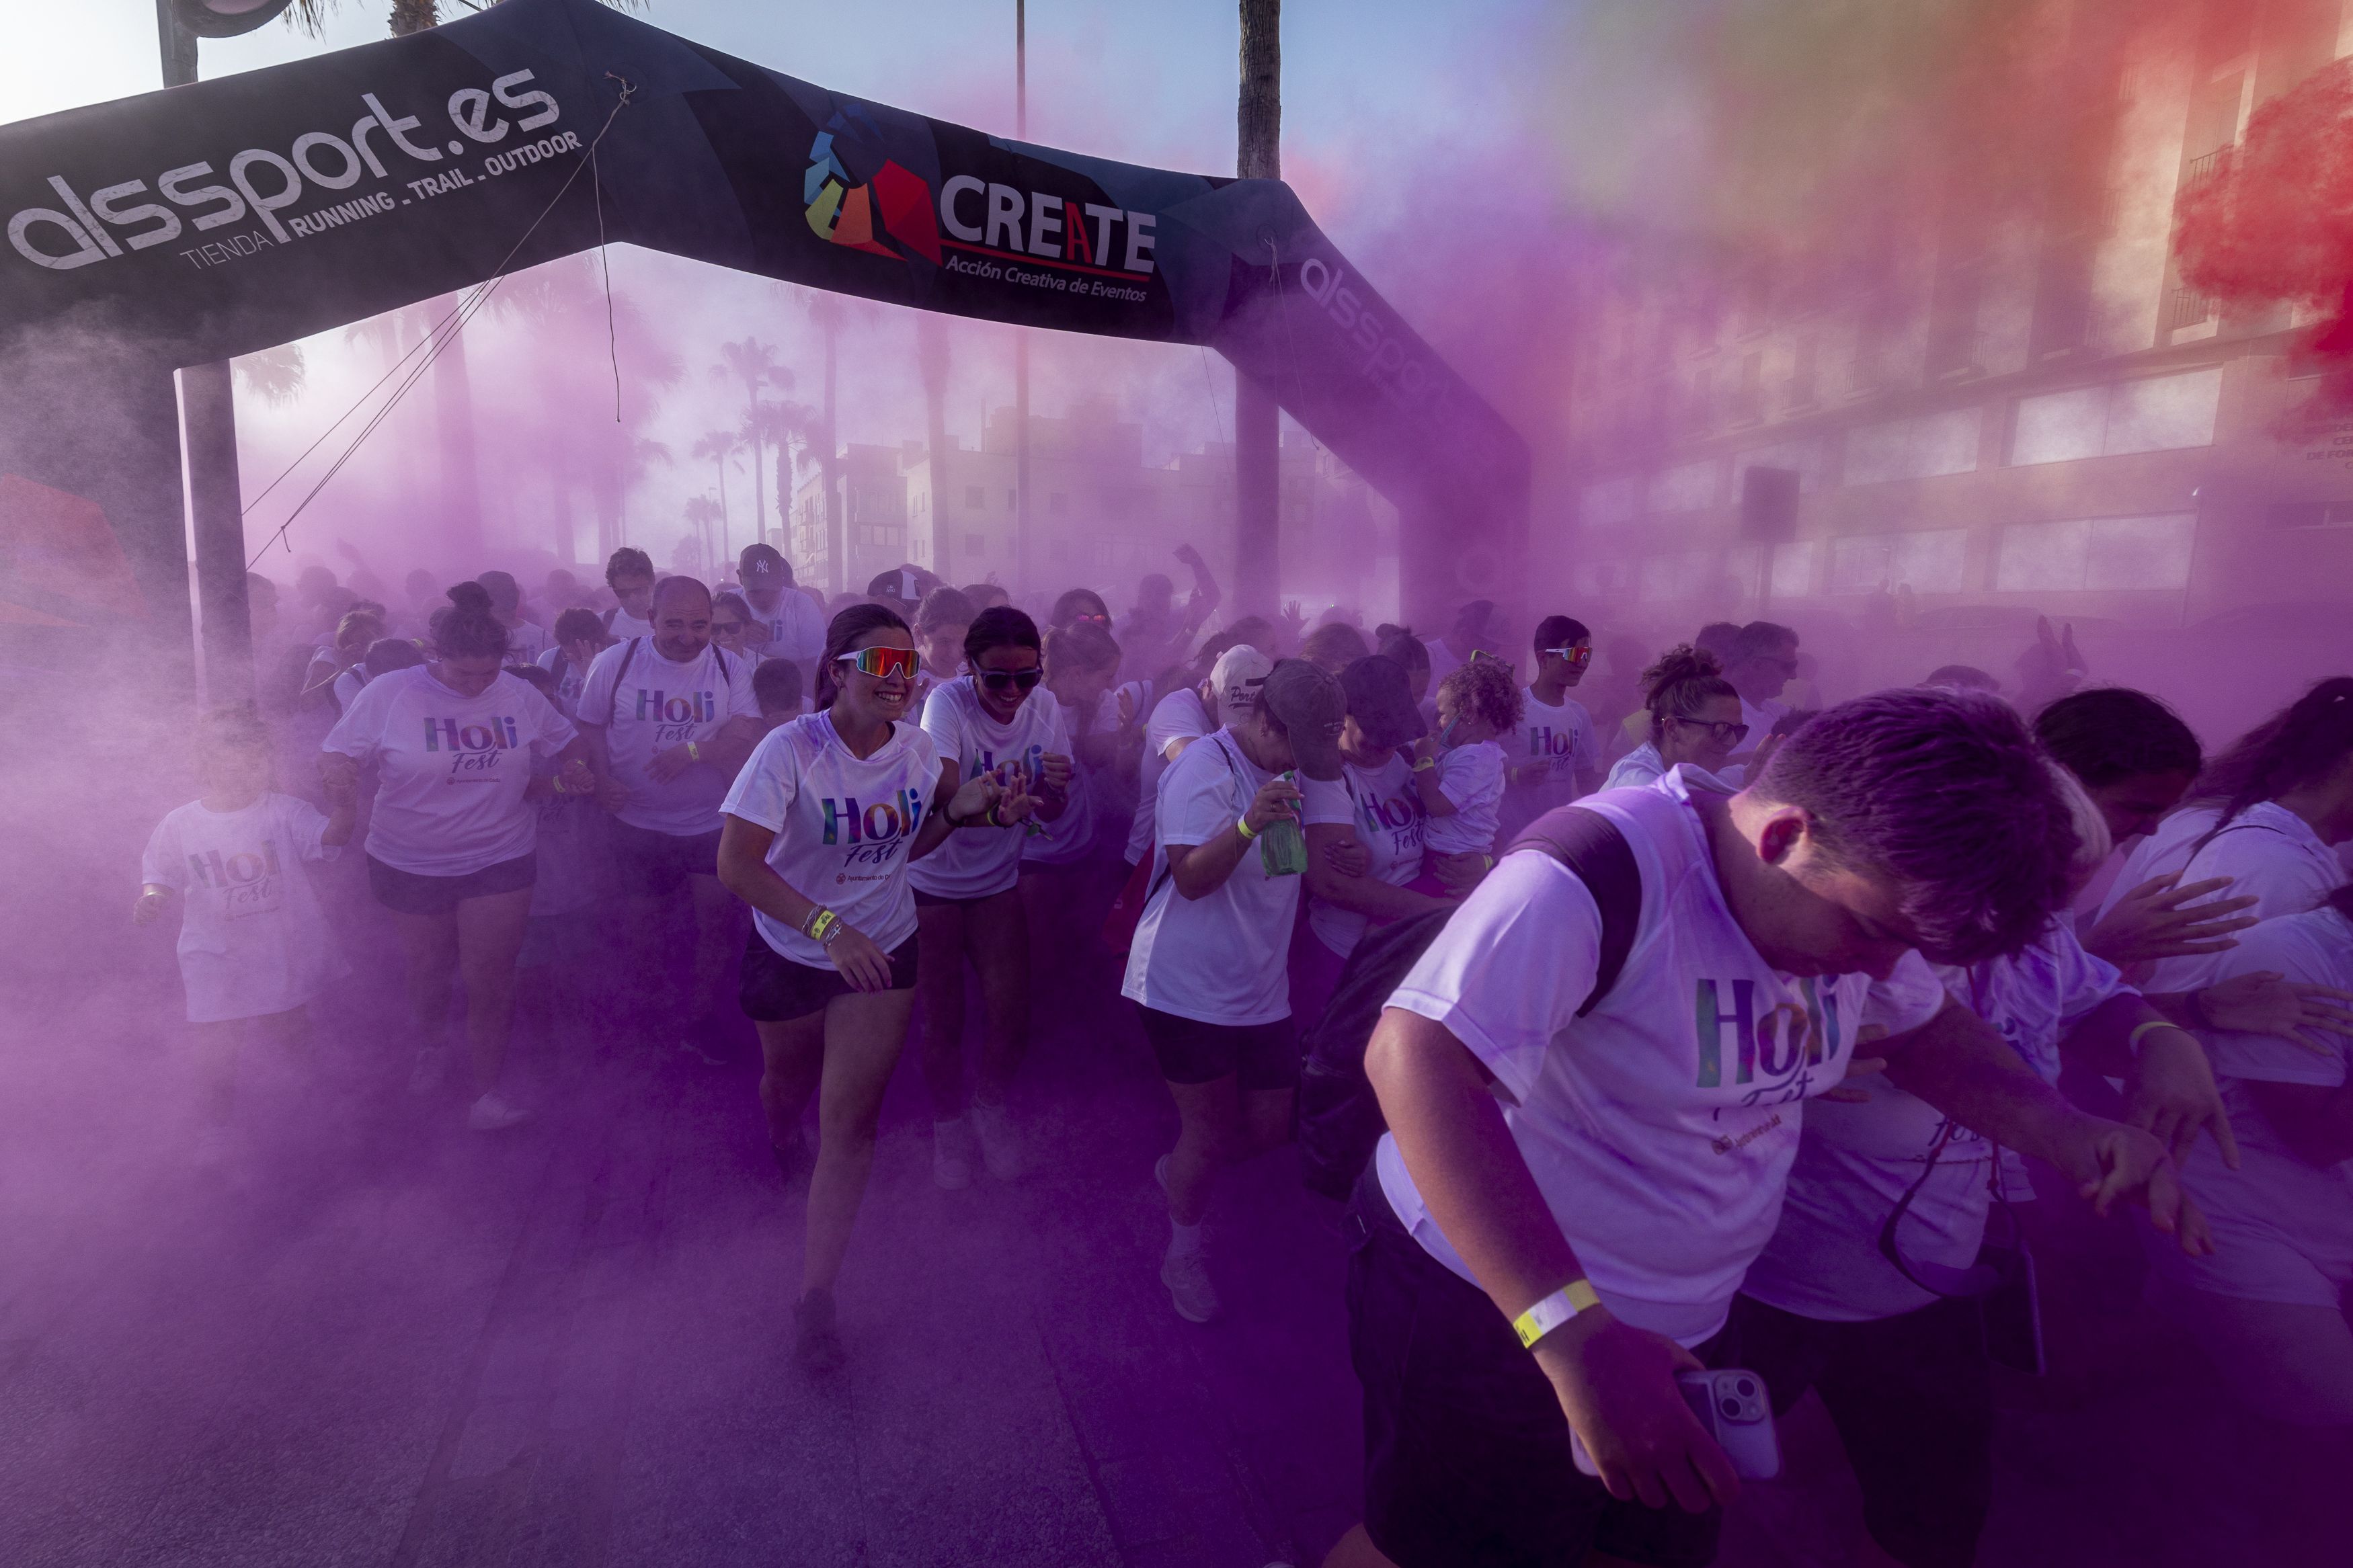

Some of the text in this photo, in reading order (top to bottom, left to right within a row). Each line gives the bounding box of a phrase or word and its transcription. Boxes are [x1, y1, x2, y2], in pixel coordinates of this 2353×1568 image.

[180, 231, 274, 269] TIENDA
[288, 192, 395, 237] RUNNING
[407, 168, 474, 200] TRAIL
[484, 131, 583, 175] OUTDOOR
[941, 175, 1156, 273] CREATE
[945, 255, 1147, 302] Acción Creativa de Eventos
[636, 689, 715, 723] Holi
[424, 716, 518, 752] Holi
[655, 723, 697, 742] Fest
[1530, 727, 1579, 757] Holi
[452, 748, 502, 773] Fest
[822, 788, 922, 845] Holi
[1360, 779, 1426, 832] Hol
[844, 837, 903, 867] Fest
[1391, 820, 1425, 856] Fest
[188, 839, 281, 889] Hol
[223, 878, 272, 909] Fest
[1696, 974, 1841, 1088] Holi
